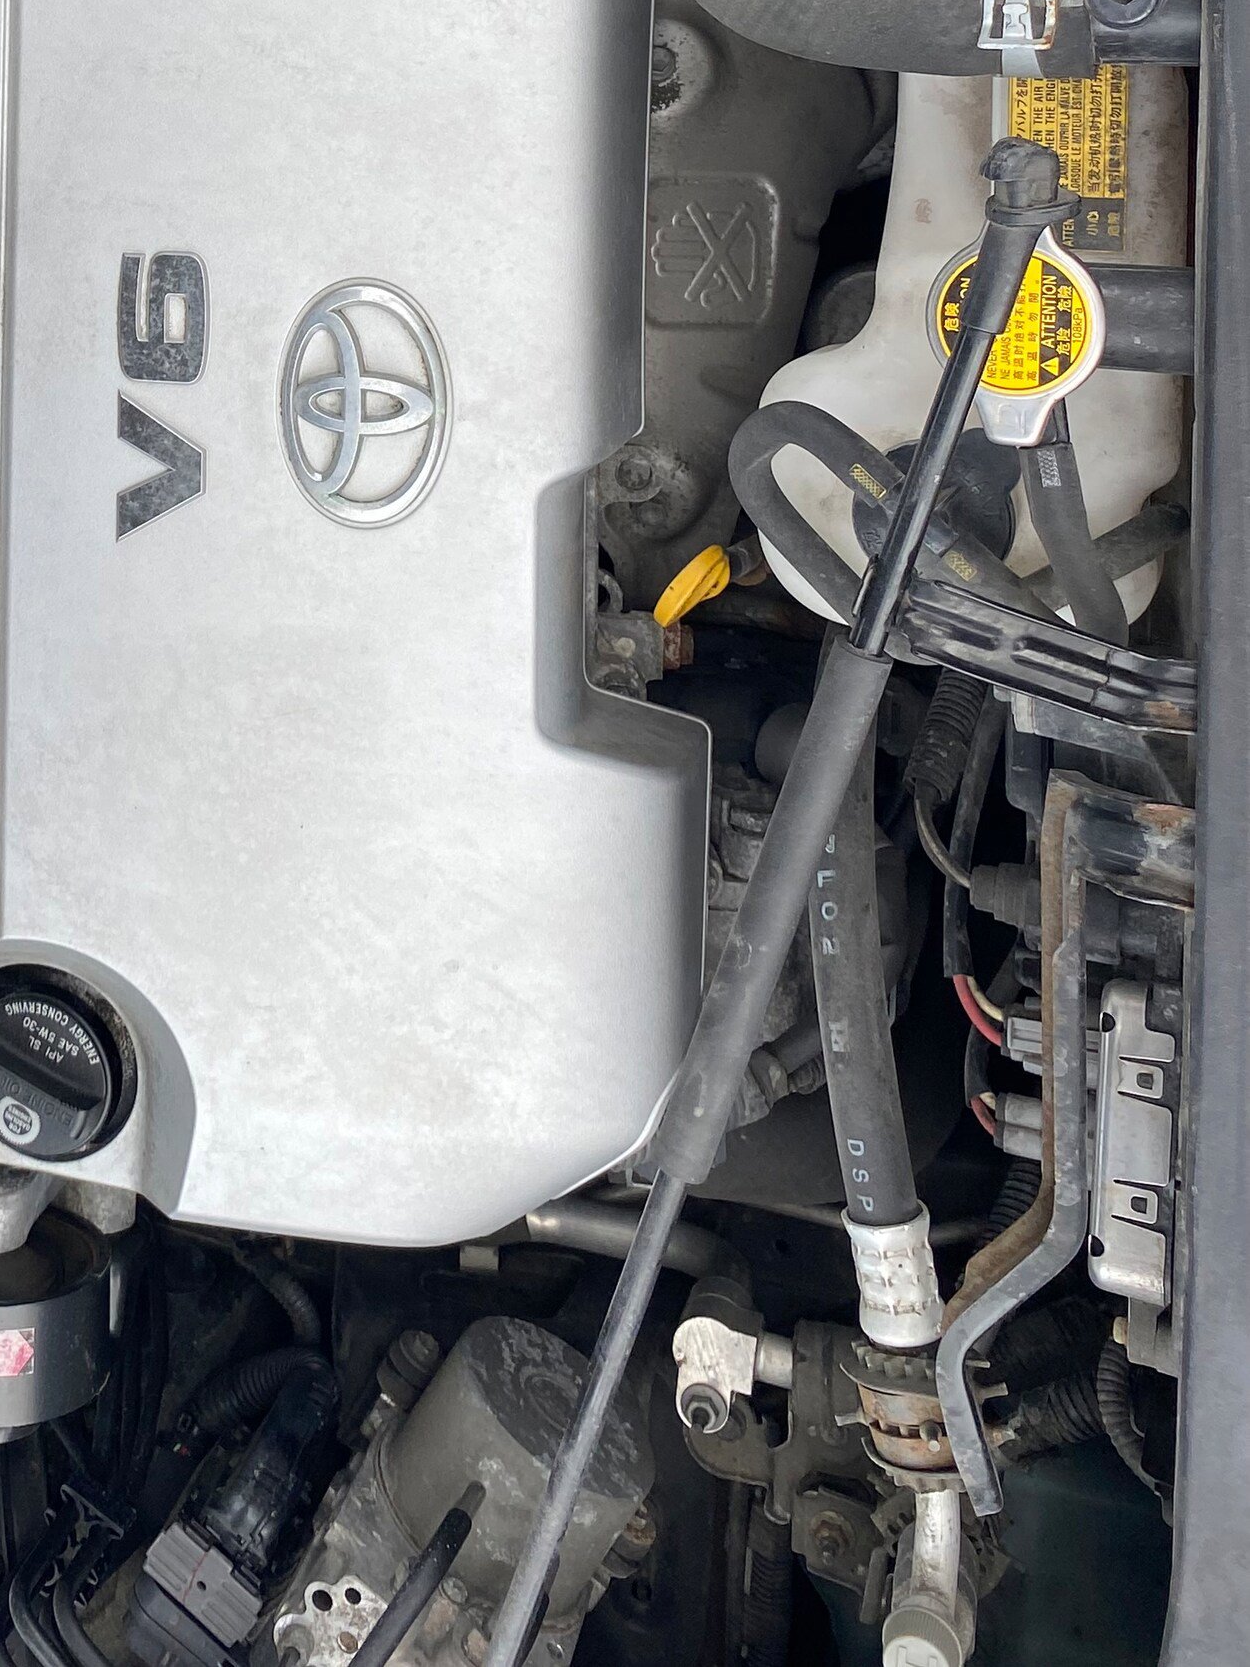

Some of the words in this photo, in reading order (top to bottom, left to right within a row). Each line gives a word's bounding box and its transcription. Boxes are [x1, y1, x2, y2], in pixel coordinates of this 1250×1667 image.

[1034, 86, 1044, 103] AIR
[1060, 86, 1071, 110] VALVE
[1072, 97, 1082, 110] EST
[1033, 107, 1044, 125] THE
[1045, 107, 1056, 125] THE
[1060, 111, 1071, 120] LA
[1059, 122, 1070, 151] OUVRIR
[1071, 113, 1082, 145] MOTEUR
[1071, 147, 1081, 156] LE
[1070, 158, 1081, 193] LORSQUE
[1085, 210, 1100, 236] 小心
[1040, 275, 1057, 349] ATTENTION
[1072, 308, 1083, 344] 108kPa
[1000, 337, 1012, 366] JAMAIS
[1000, 369, 1011, 381] NE
[114, 248, 210, 545] V6
[4, 1000, 70, 1026] CONSERVING
[22, 1016, 56, 1043] 5W-30
[27, 1035, 42, 1051] SL
[45, 1045, 65, 1064] API
[58, 1037, 80, 1057] SAE
[67, 1022, 101, 1066] ENERGY
